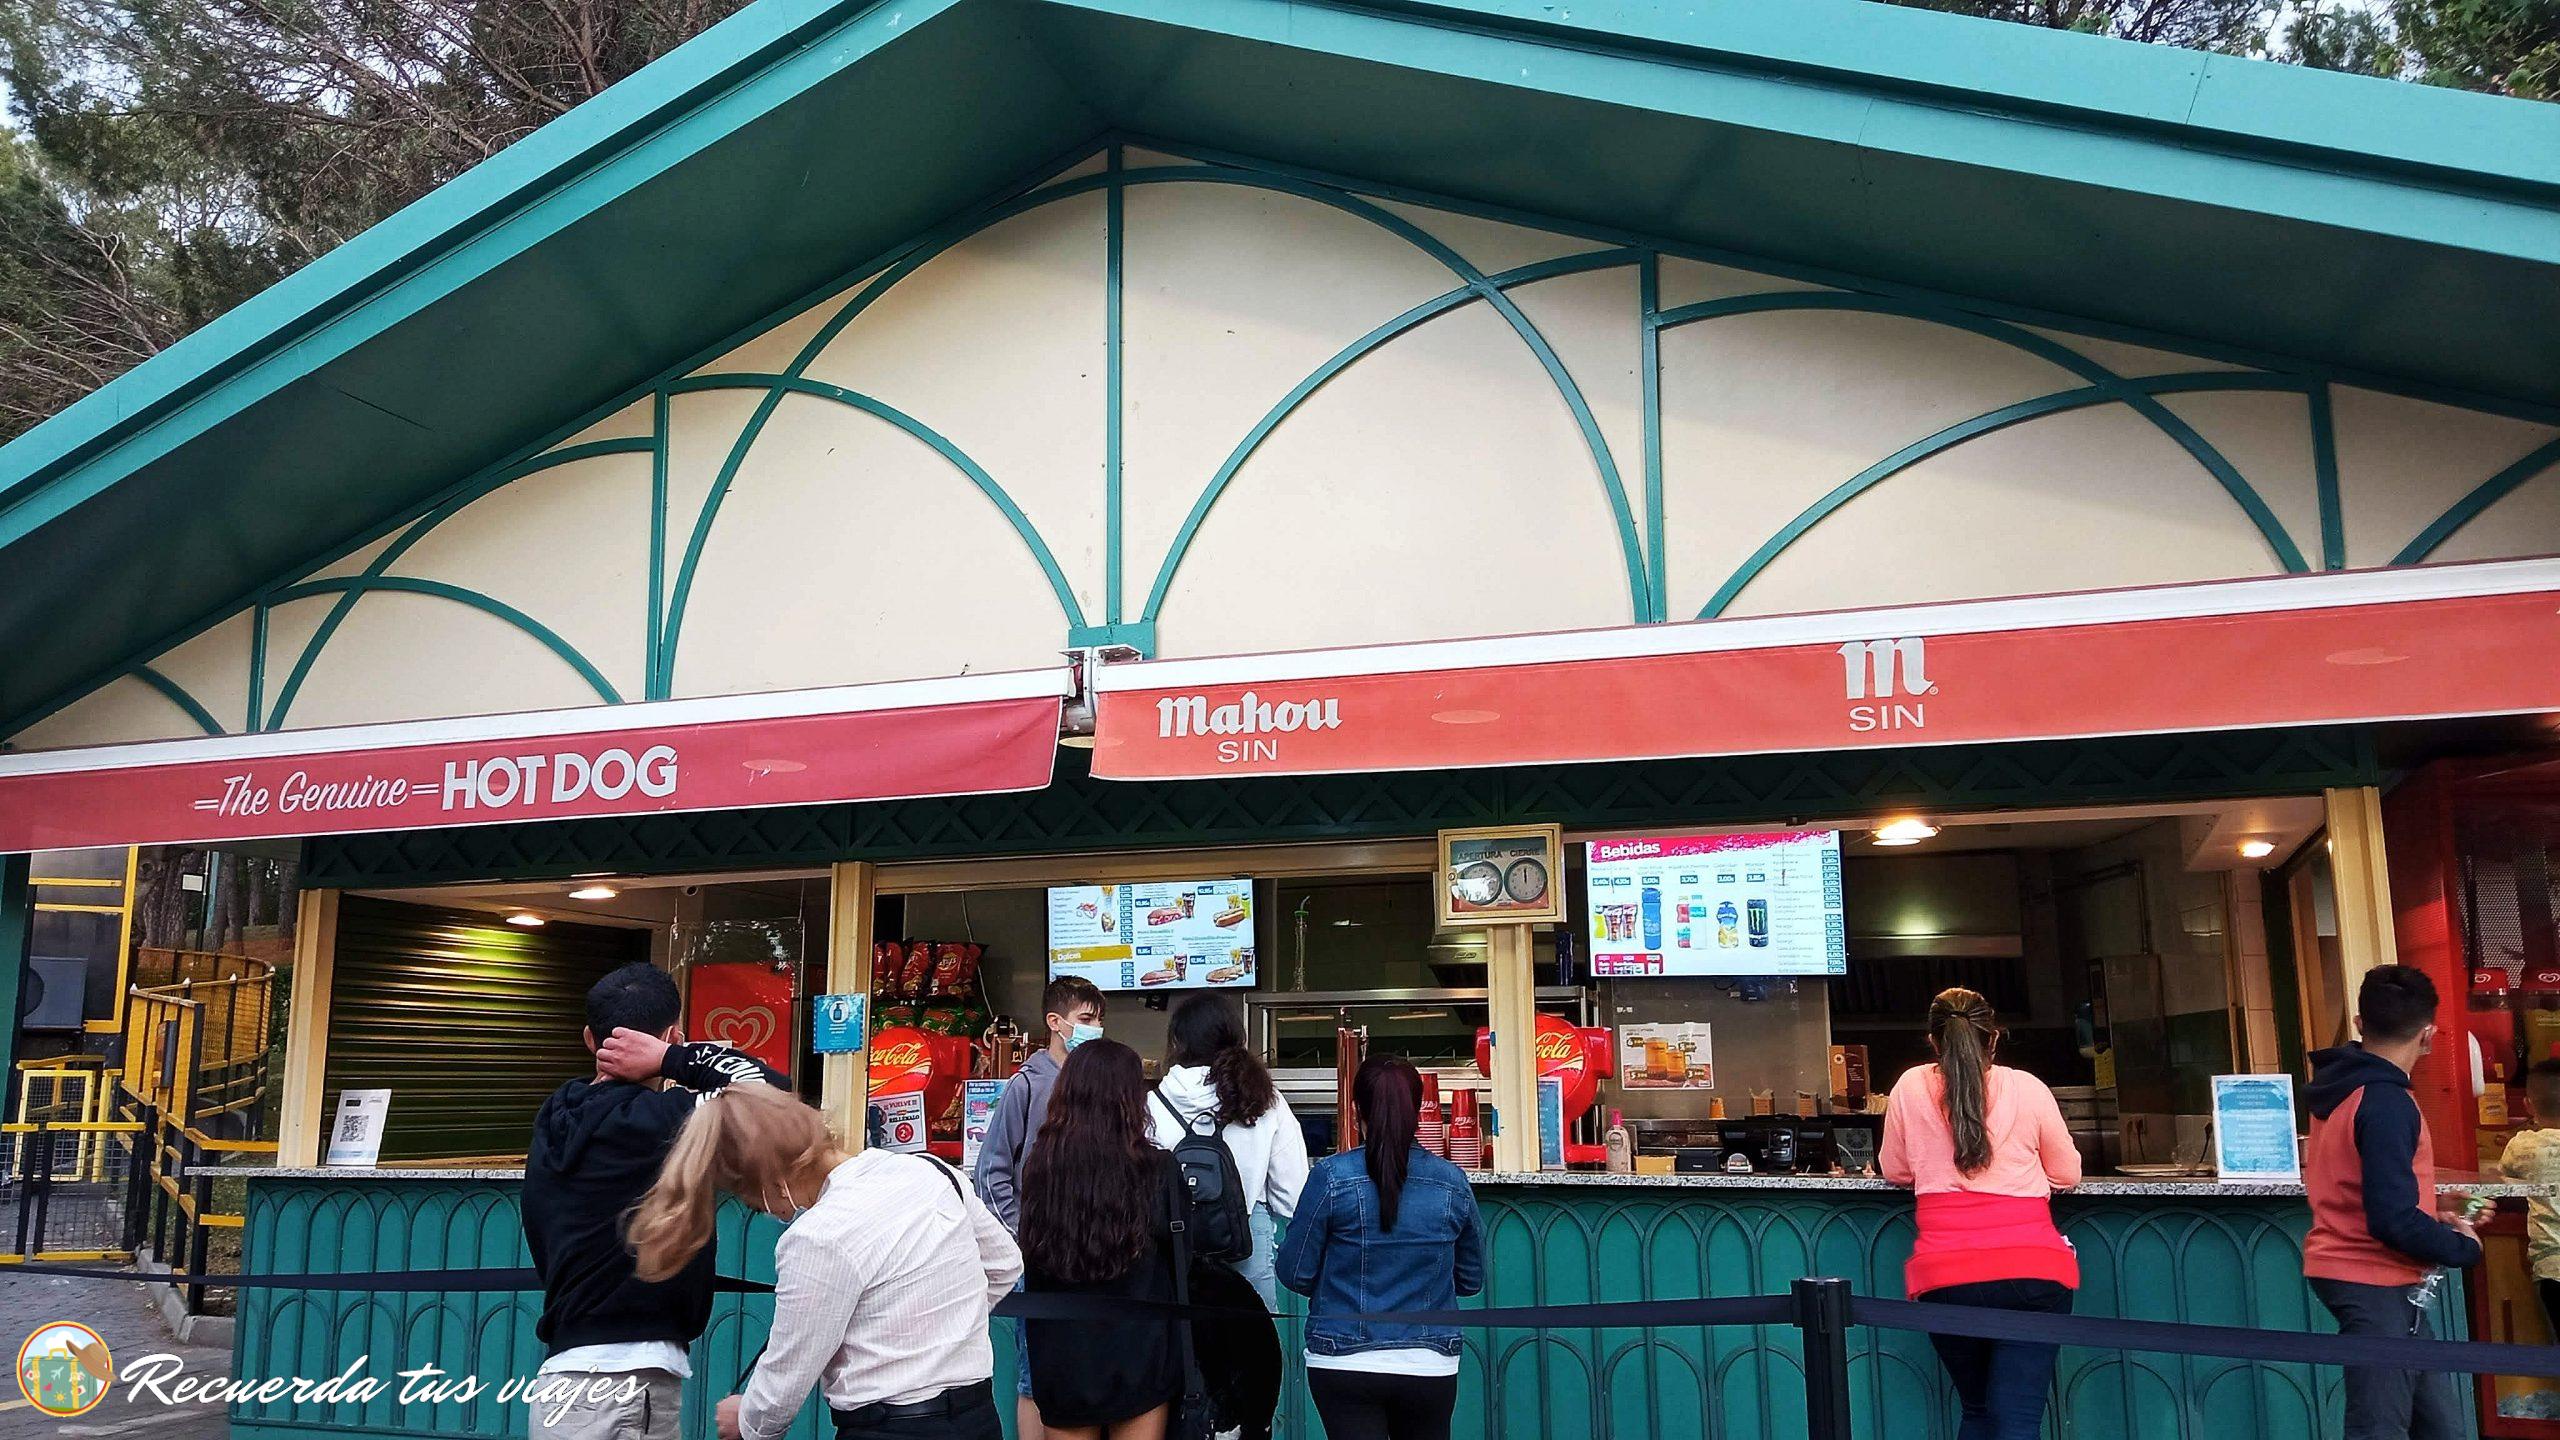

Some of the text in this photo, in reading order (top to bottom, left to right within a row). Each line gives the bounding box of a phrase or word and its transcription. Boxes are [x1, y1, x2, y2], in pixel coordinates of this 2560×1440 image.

[1156, 691, 1343, 738] Mahou
[1849, 703, 1925, 732] SIN
[1217, 739, 1278, 763] SIN
[218, 745, 679, 818] The Genuine HOT DOG
[1458, 850, 1503, 861] APERTURA
[1600, 842, 1661, 859] Bebidas
